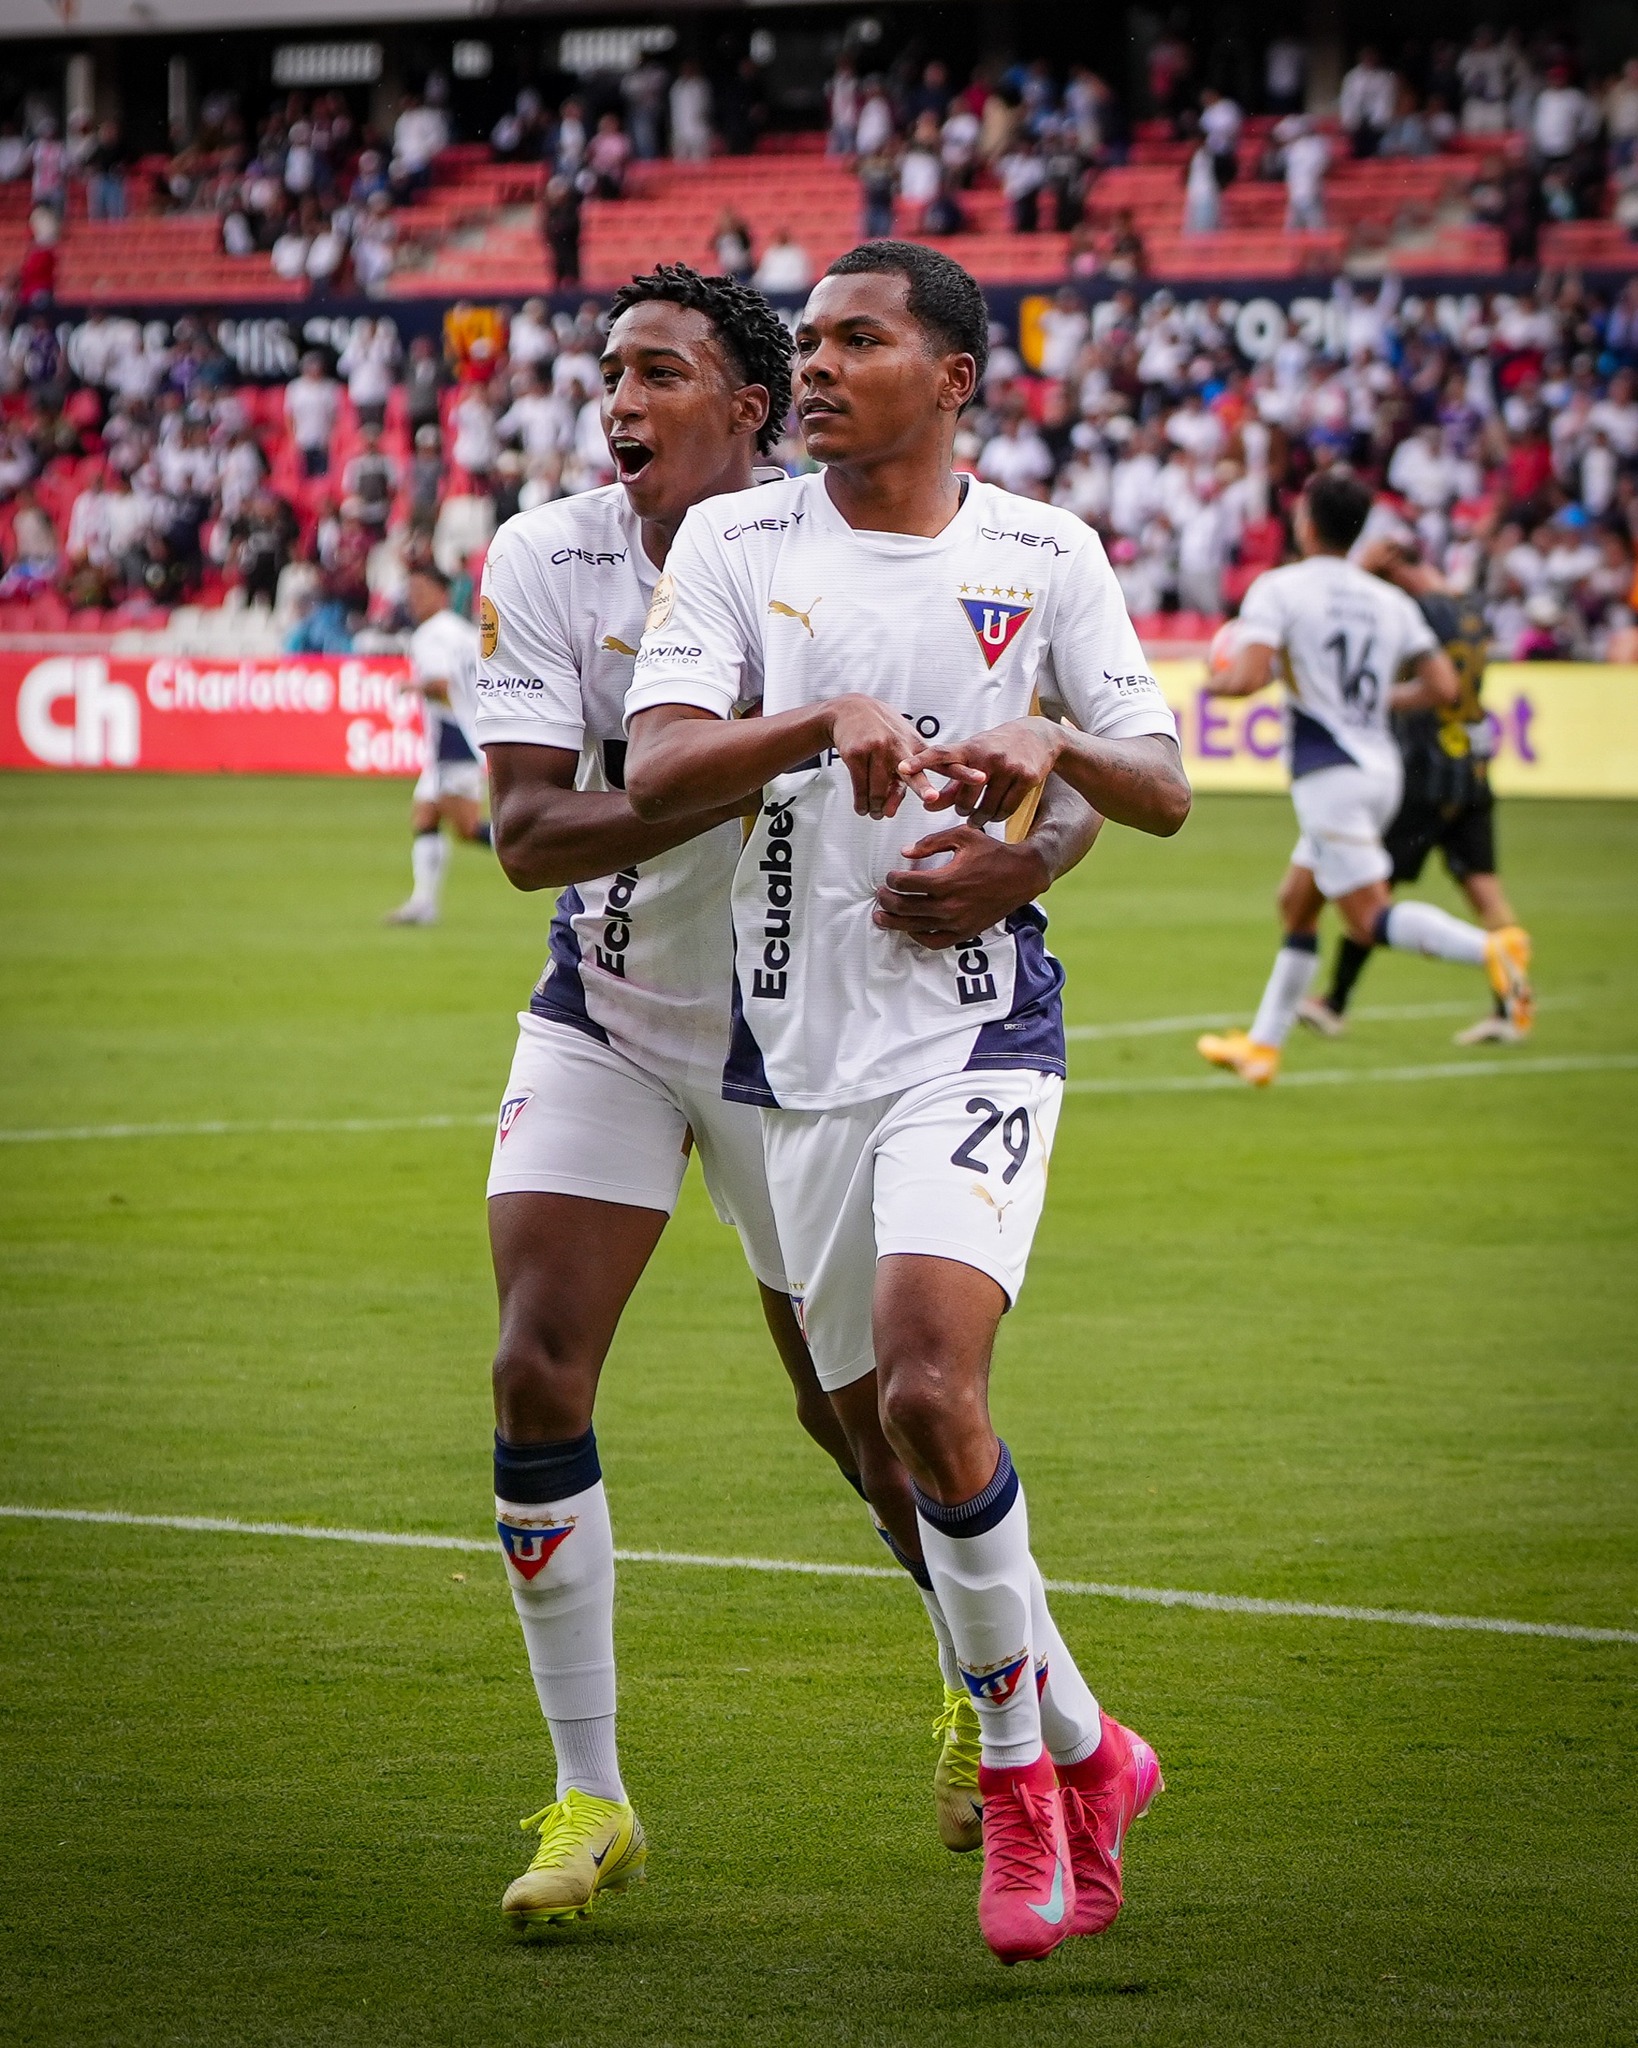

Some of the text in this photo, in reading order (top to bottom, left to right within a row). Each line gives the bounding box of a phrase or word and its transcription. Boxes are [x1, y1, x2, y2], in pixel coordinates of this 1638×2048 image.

[551, 547, 629, 565] CHERY
[982, 608, 1010, 645] U
[17, 657, 141, 767] Ch
[146, 660, 335, 713] Charlotte
[1325, 628, 1379, 713] 16
[751, 795, 798, 1000] Ecuabet
[950, 1096, 1030, 1185] 29
